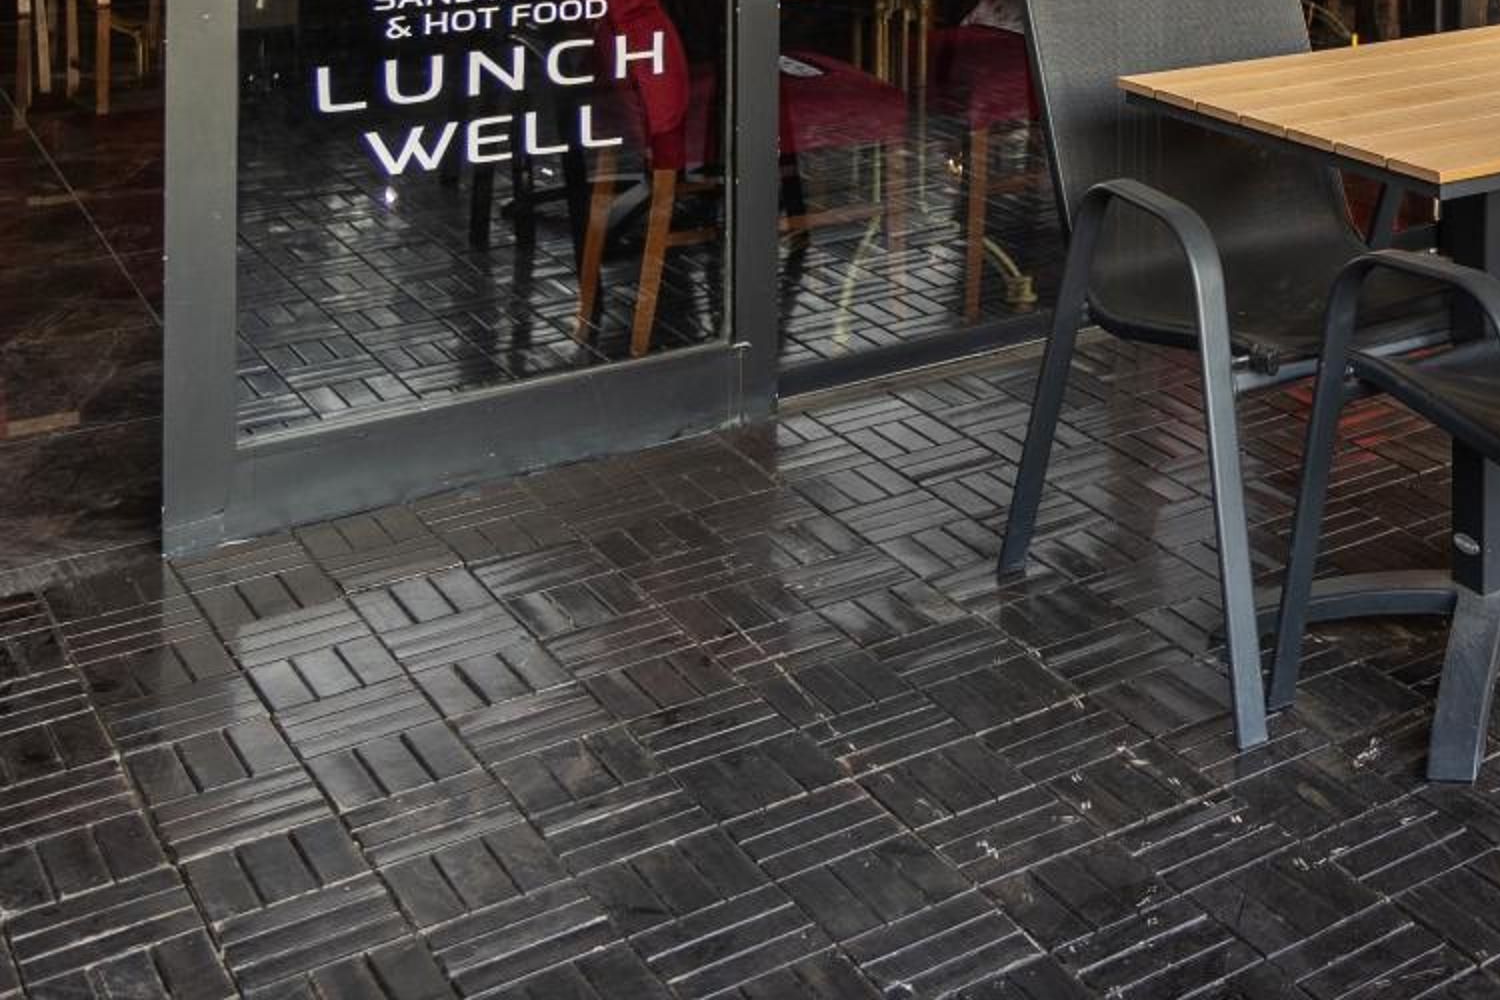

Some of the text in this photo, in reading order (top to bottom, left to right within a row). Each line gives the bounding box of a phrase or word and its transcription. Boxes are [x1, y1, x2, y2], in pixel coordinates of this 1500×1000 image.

[385, 15, 413, 40] &
[423, 6, 499, 36] HOT
[315, 31, 665, 113] LUNCH
[363, 105, 624, 176] WELL
